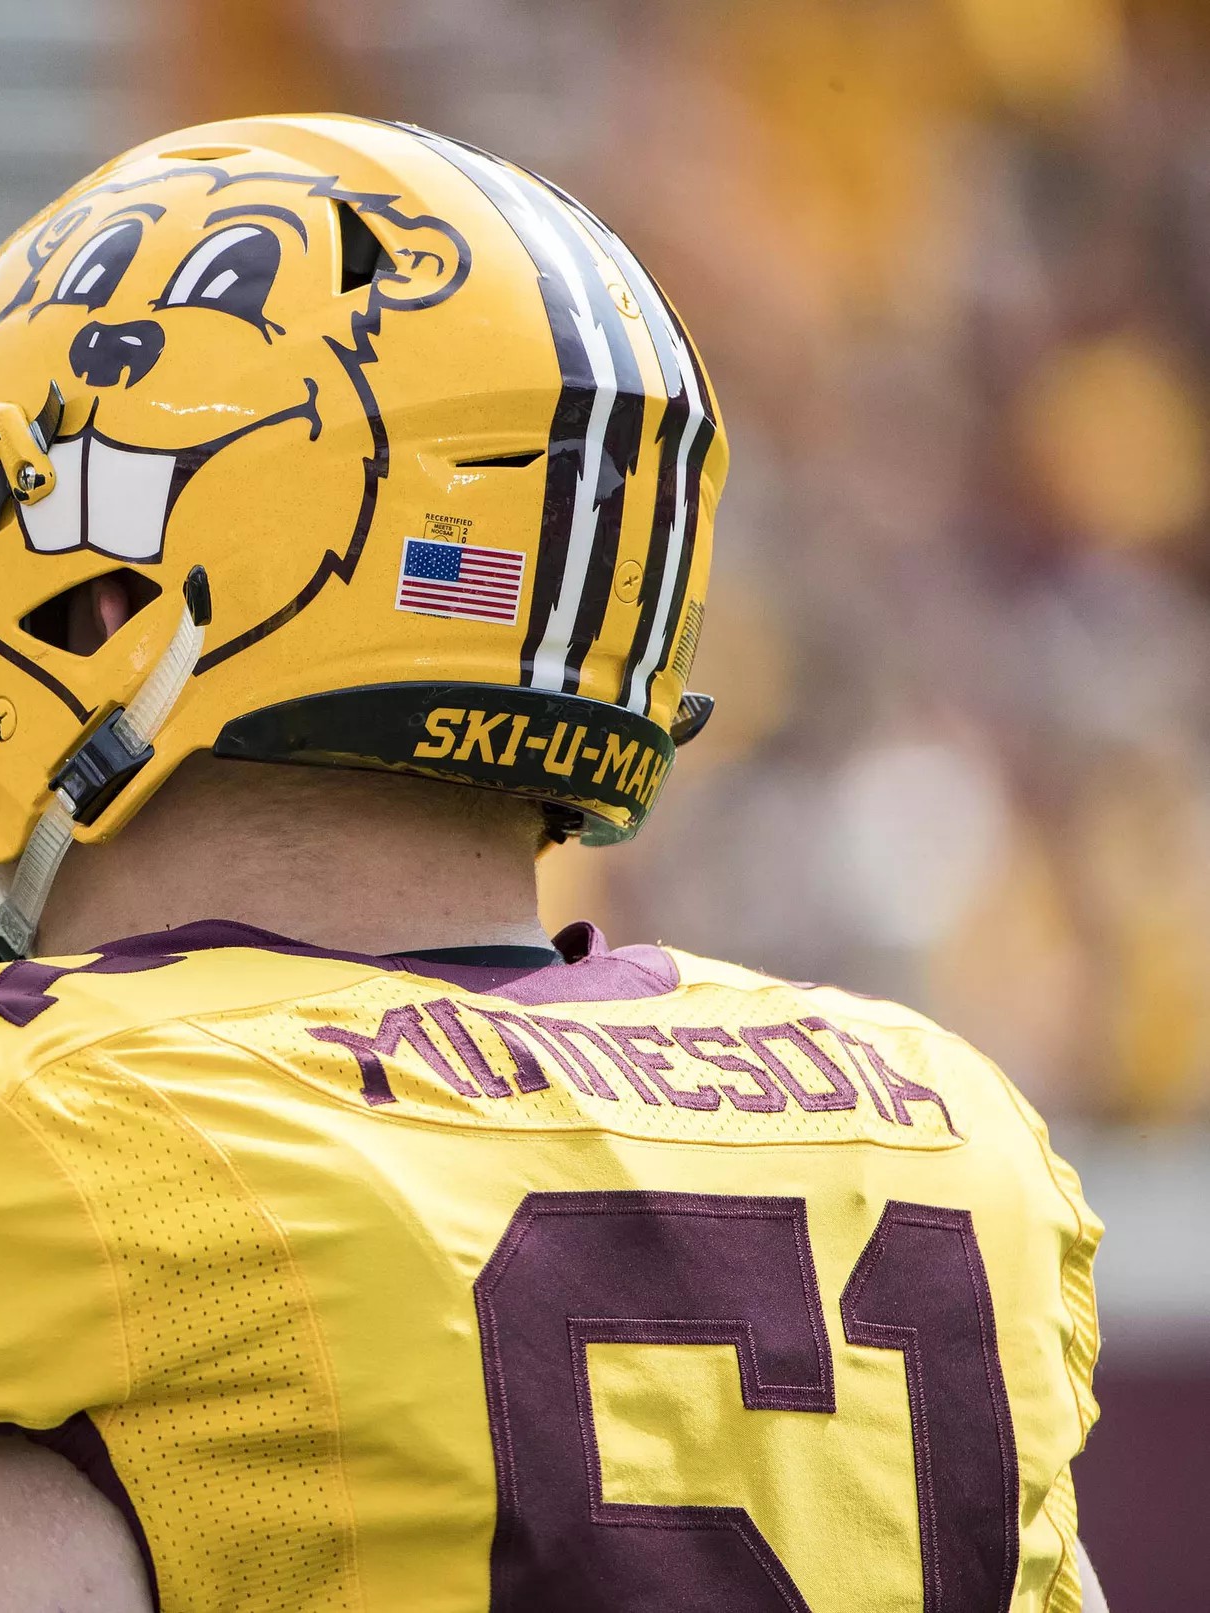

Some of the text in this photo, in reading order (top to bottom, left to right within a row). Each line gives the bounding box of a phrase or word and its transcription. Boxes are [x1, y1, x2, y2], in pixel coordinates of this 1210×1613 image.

[425, 513, 473, 527] RECERTIFIED
[433, 523, 453, 532] MEETS
[304, 997, 964, 1141] MINNESOTA
